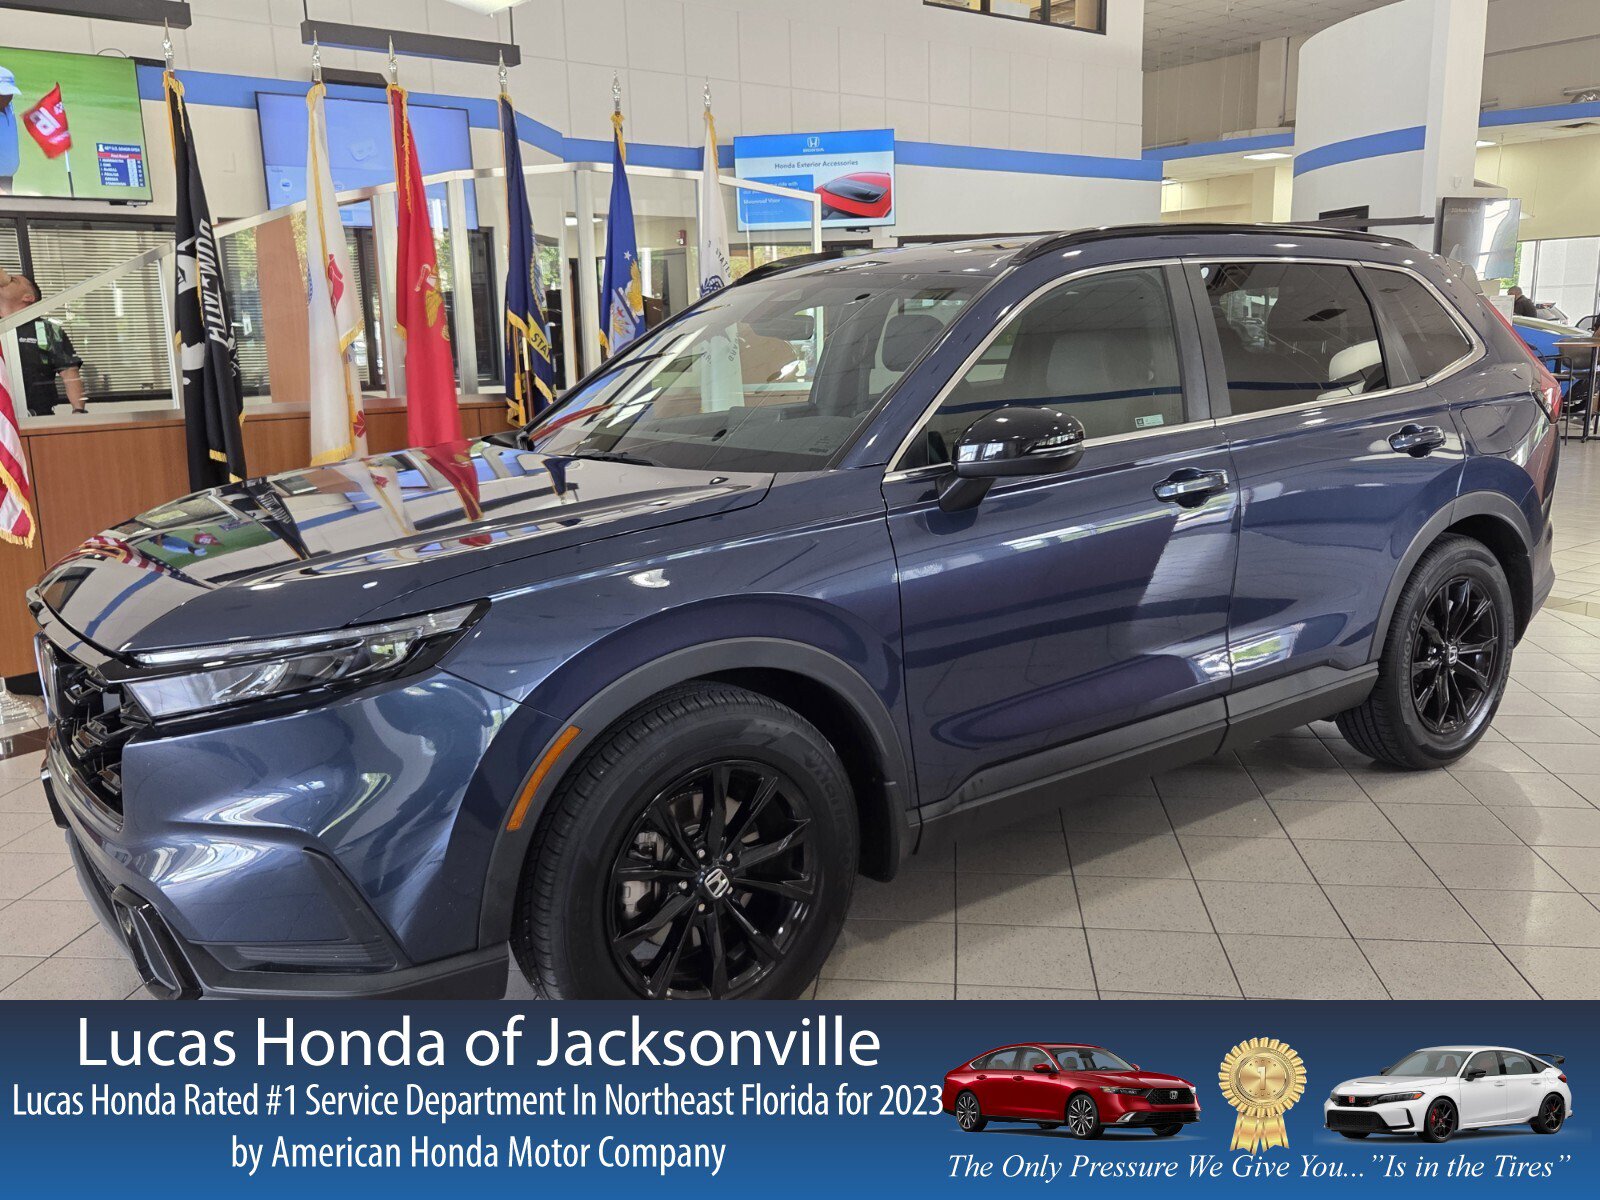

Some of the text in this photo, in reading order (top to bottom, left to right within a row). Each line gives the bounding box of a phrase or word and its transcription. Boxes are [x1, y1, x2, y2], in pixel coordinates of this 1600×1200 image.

[774, 159, 859, 170] Honda Exterior Accessories
[530, 332, 552, 359] STA
